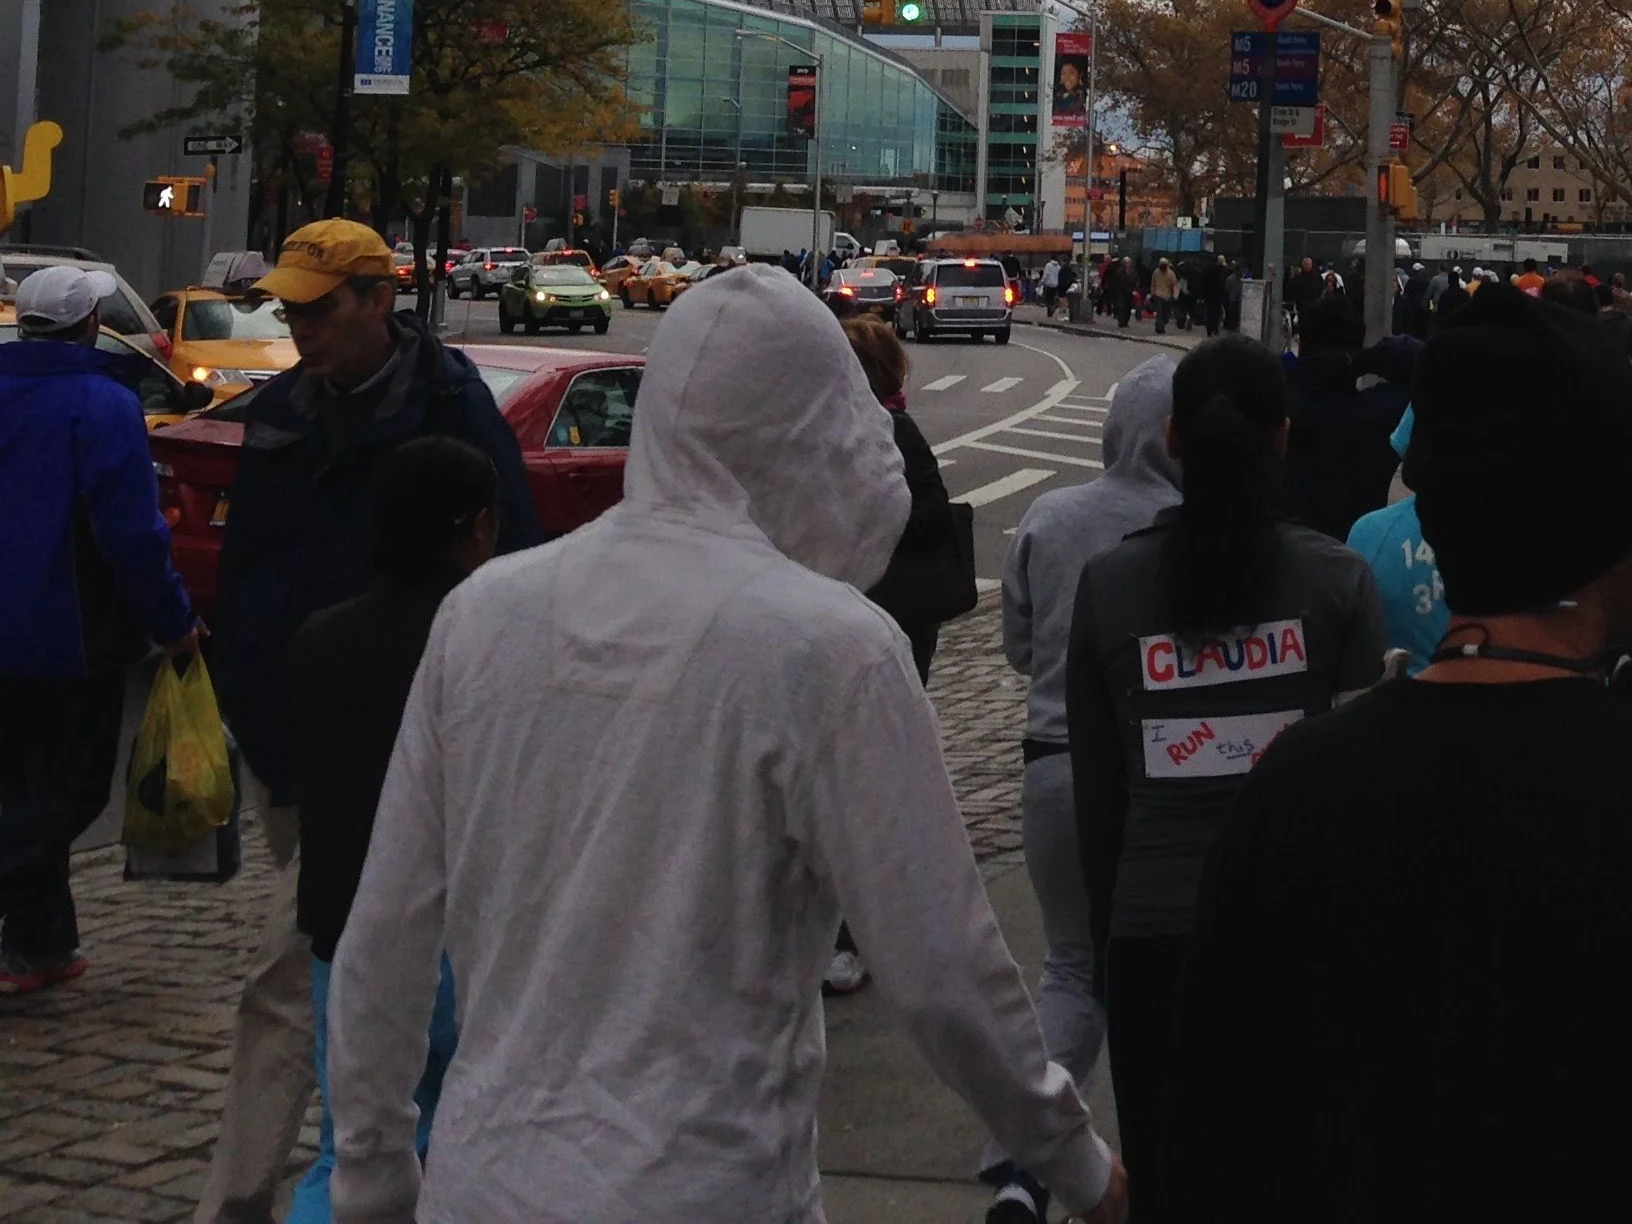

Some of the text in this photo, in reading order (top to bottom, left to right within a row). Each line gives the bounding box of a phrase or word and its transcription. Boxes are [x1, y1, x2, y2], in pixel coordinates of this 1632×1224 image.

[1234, 36, 1251, 52] M5
[1232, 59, 1250, 75] M5
[1231, 81, 1257, 98] M20
[1146, 628, 1305, 683] CLAUDIA
[1151, 725, 1167, 743] I
[1166, 721, 1216, 766] RUN
[1215, 739, 1255, 755] this
